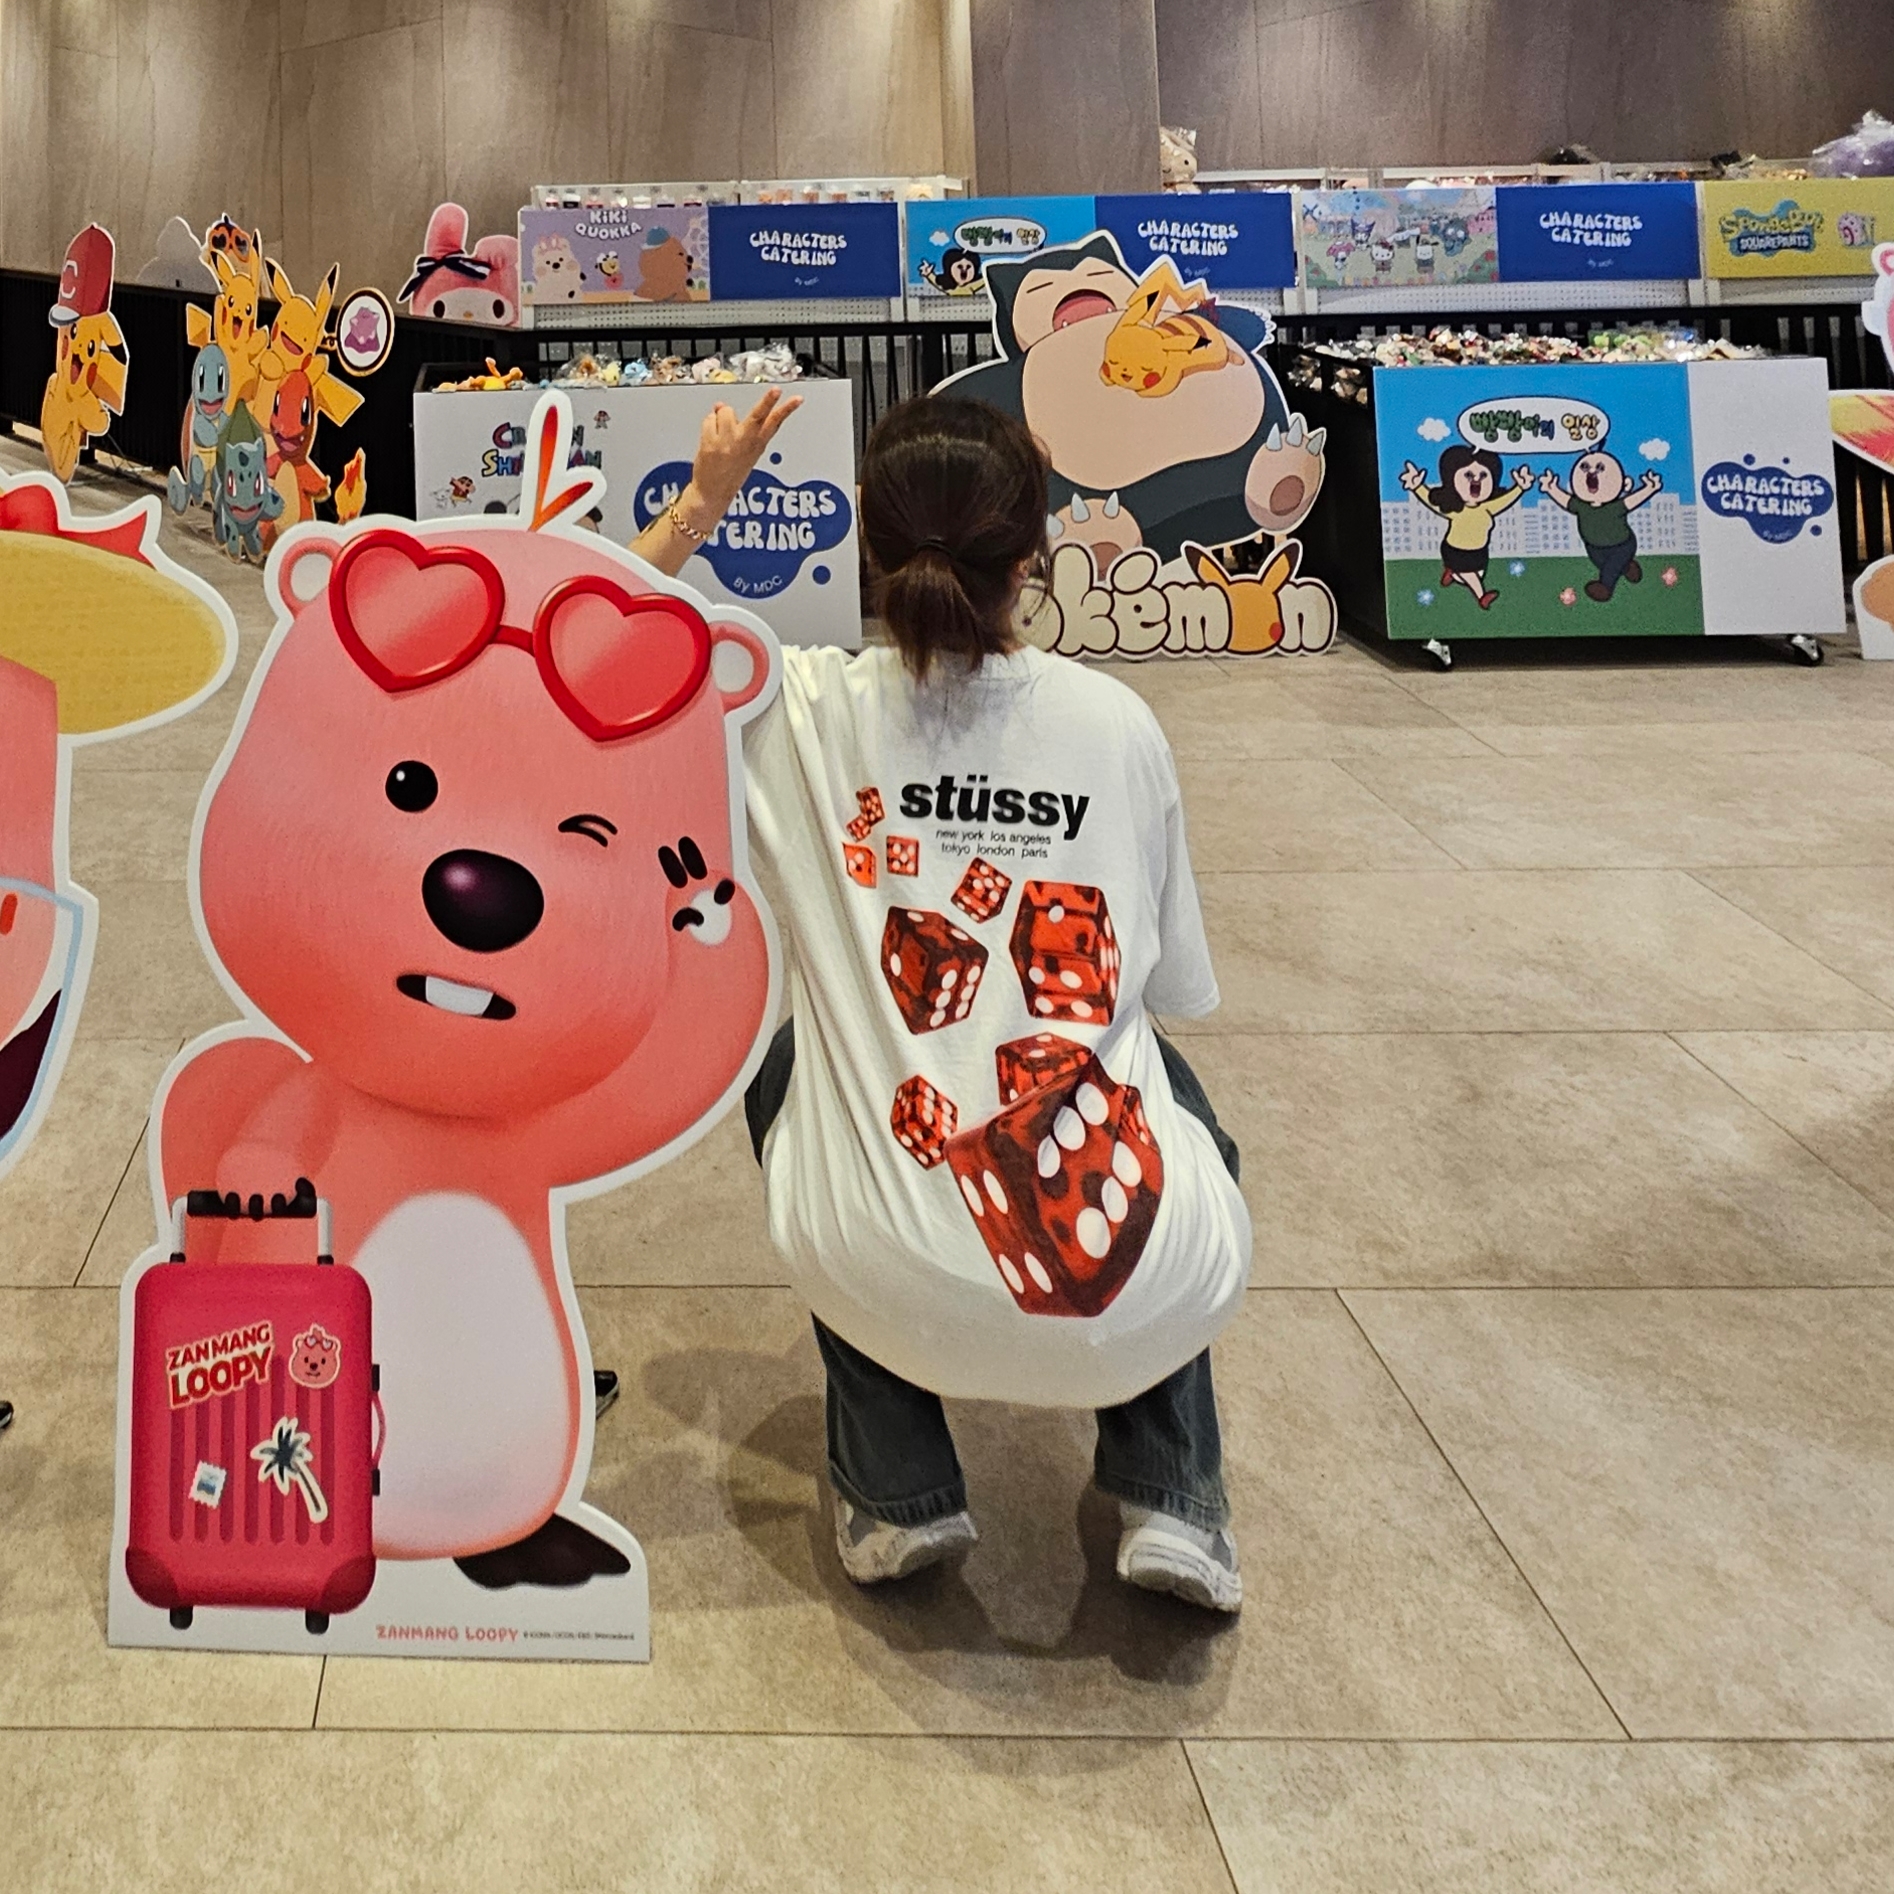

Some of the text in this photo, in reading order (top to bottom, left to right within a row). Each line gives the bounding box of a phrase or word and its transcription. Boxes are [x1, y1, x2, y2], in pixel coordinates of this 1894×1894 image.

[1138, 220, 1238, 239] CHARACTERS
[1539, 211, 1643, 230] CHARACTERS
[575, 222, 642, 240] QUOKKA
[750, 230, 847, 249] CHARACTERS
[1551, 229, 1632, 248] CATERING
[761, 246, 836, 266] CATERING
[1150, 238, 1227, 256] CATERING
[1469, 409, 1601, 443] 빵빵이의 일상
[1707, 474, 1825, 497] CHARACTERS
[643, 482, 836, 518] CHACTERS
[1721, 493, 1812, 516] CATERING
[706, 520, 815, 551] TERING
[754, 575, 783, 593] MDC
[900, 774, 1090, 841] stüssy
[936, 829, 1052, 846] new york los angeles
[941, 843, 1048, 859] tokyo london paris
[168, 1323, 270, 1371] ZANMANG
[171, 1347, 272, 1406] LOOPY
[376, 1624, 458, 1641] ZANMANG
[465, 1626, 519, 1643] LOOPY
